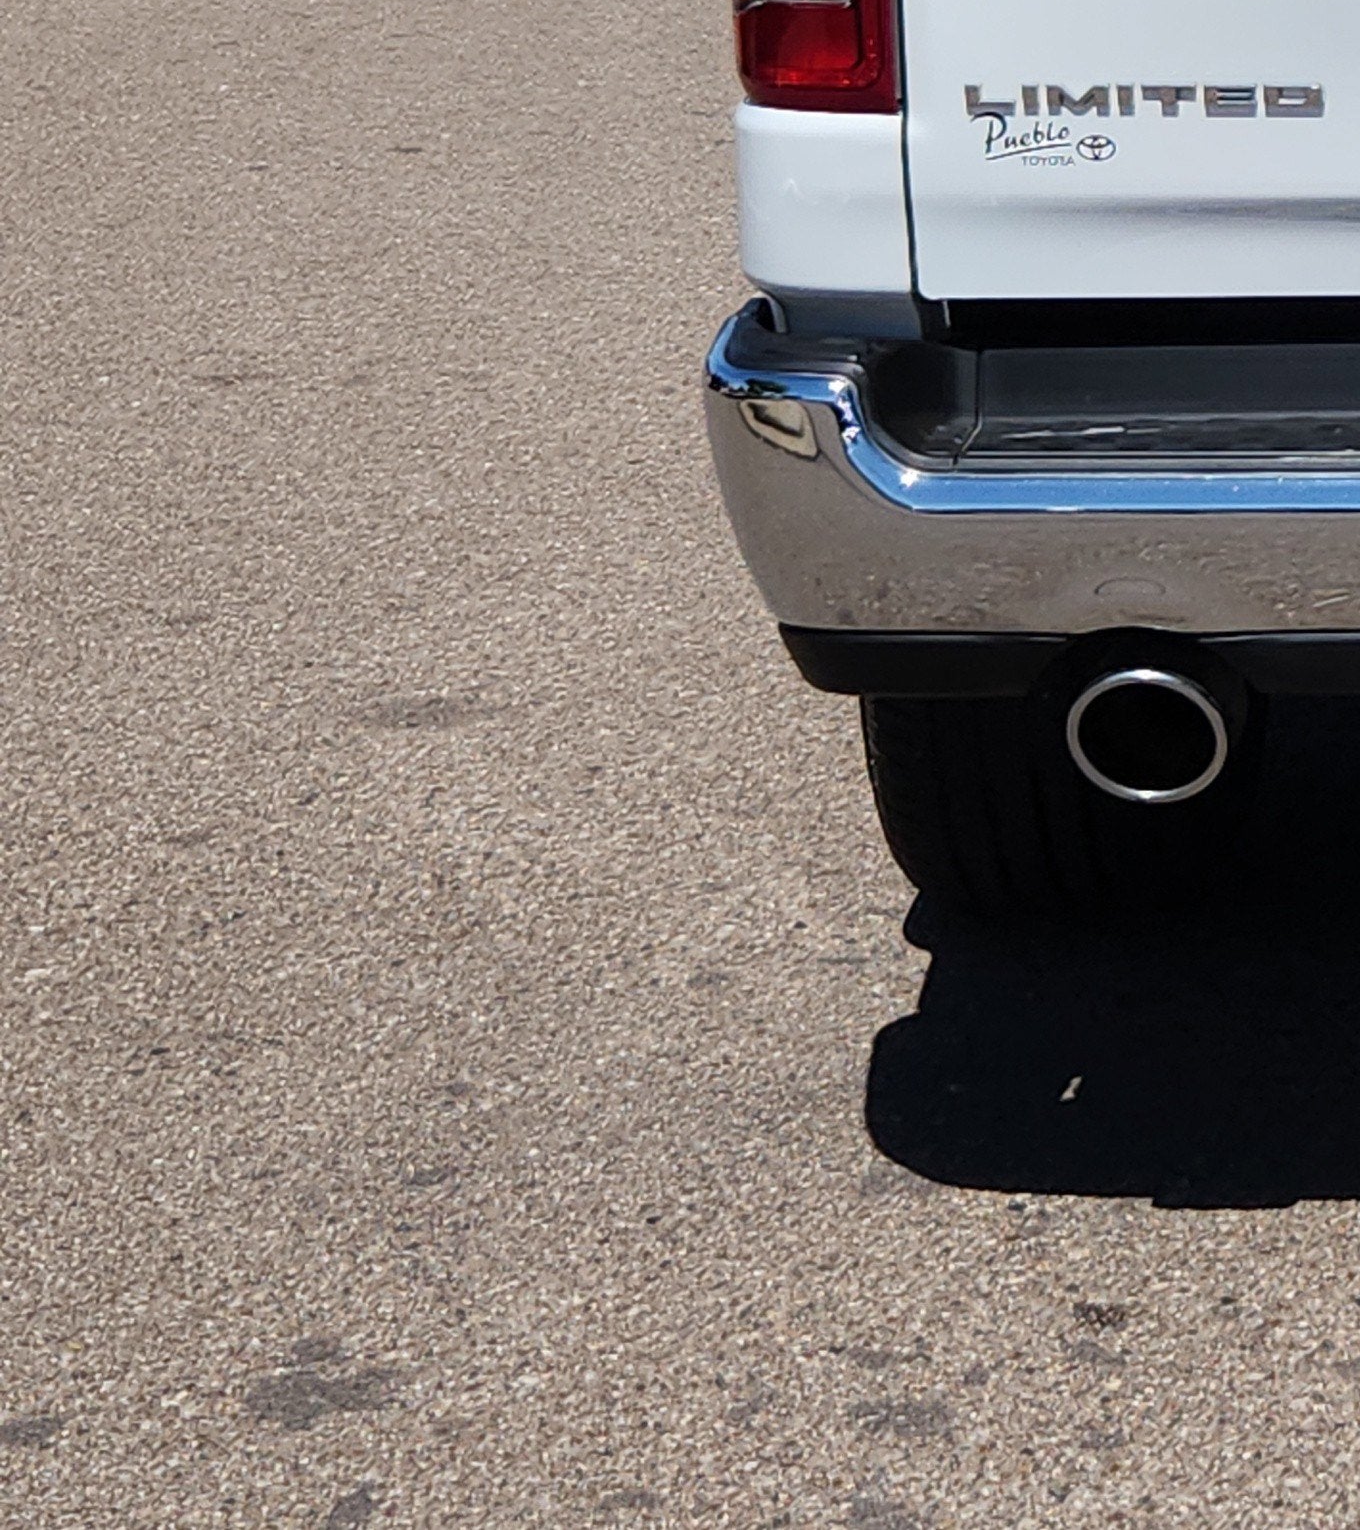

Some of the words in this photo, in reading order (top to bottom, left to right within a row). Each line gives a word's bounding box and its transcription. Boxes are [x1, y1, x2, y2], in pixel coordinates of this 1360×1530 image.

[963, 83, 1326, 118] LIMITED
[970, 111, 1071, 154] Pueblo
[1021, 155, 1076, 167] TOYOTA
